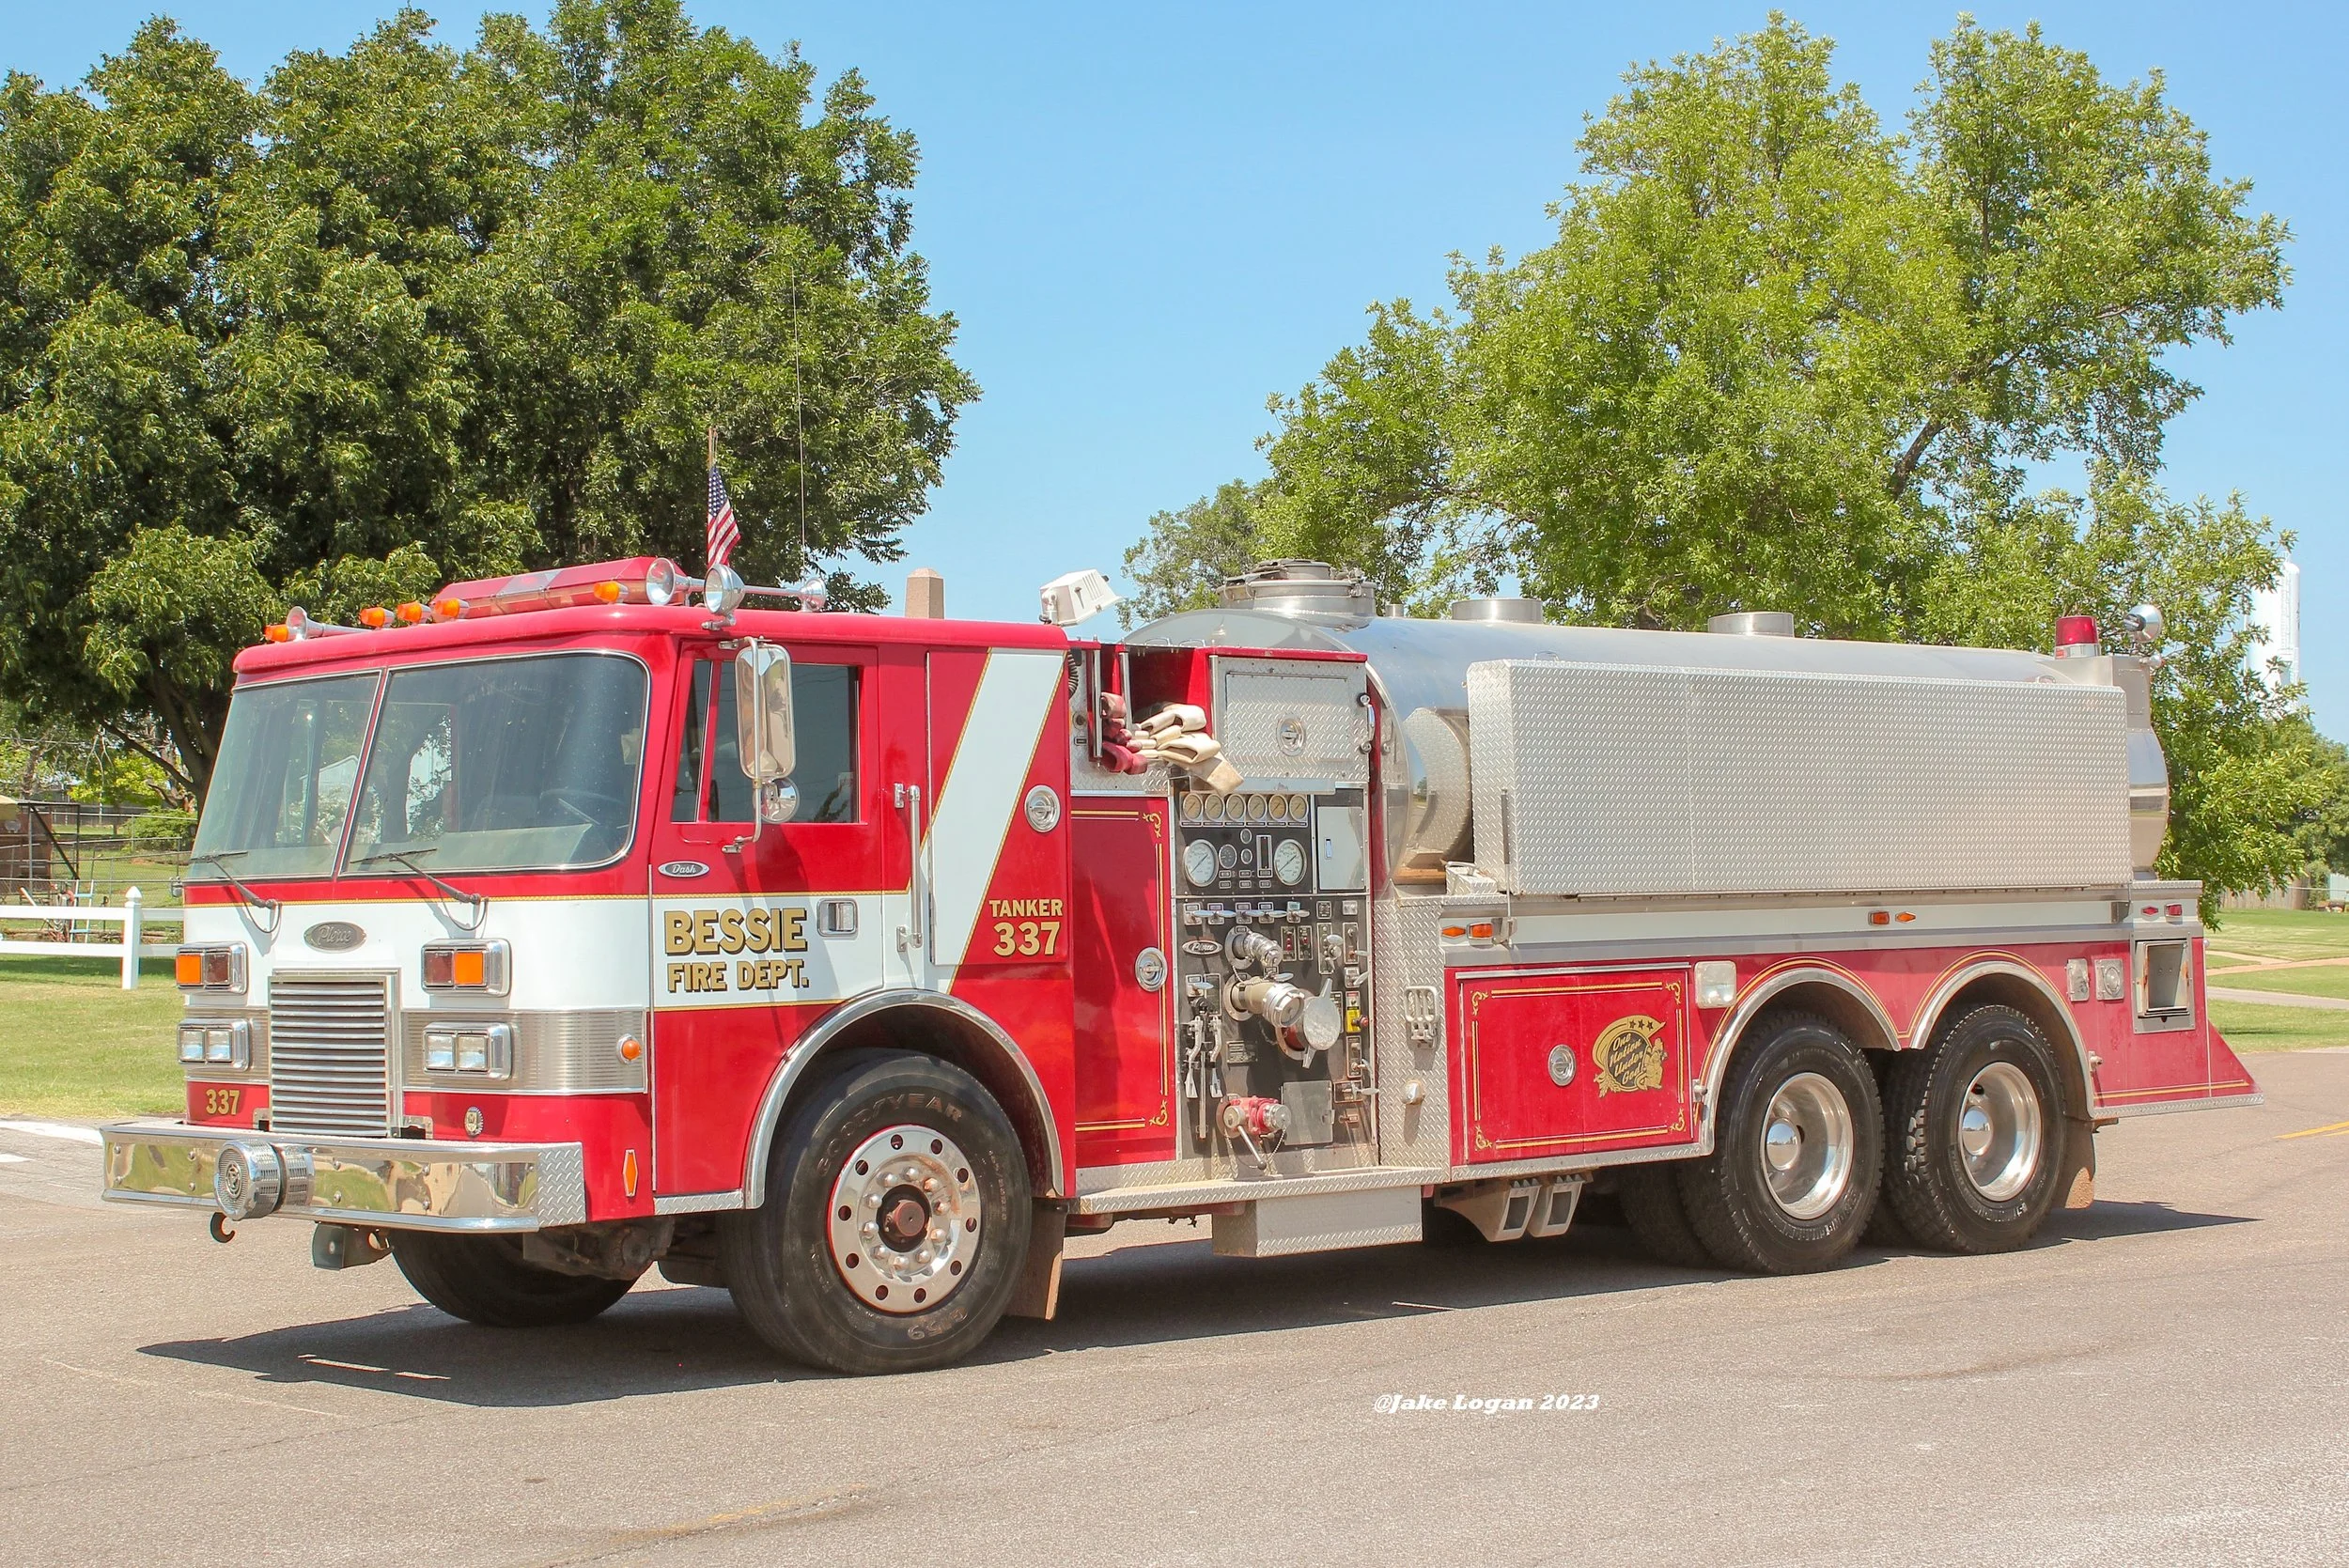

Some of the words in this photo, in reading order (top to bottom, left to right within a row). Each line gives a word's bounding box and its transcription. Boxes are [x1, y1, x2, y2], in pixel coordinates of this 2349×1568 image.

[672, 863, 697, 874] Dash
[988, 898, 1064, 918] TANKER
[664, 908, 808, 955] BESSIE
[993, 921, 1061, 956] 337
[667, 961, 727, 993] FIRE
[737, 958, 809, 990] DEPT.
[1609, 1038, 1641, 1067] Nation
[1612, 1032, 1631, 1051] One
[1614, 1051, 1643, 1077] Under
[1622, 1062, 1641, 1085] God
[206, 1089, 241, 1115] 337
[817, 1093, 963, 1176] GOODYEAR
